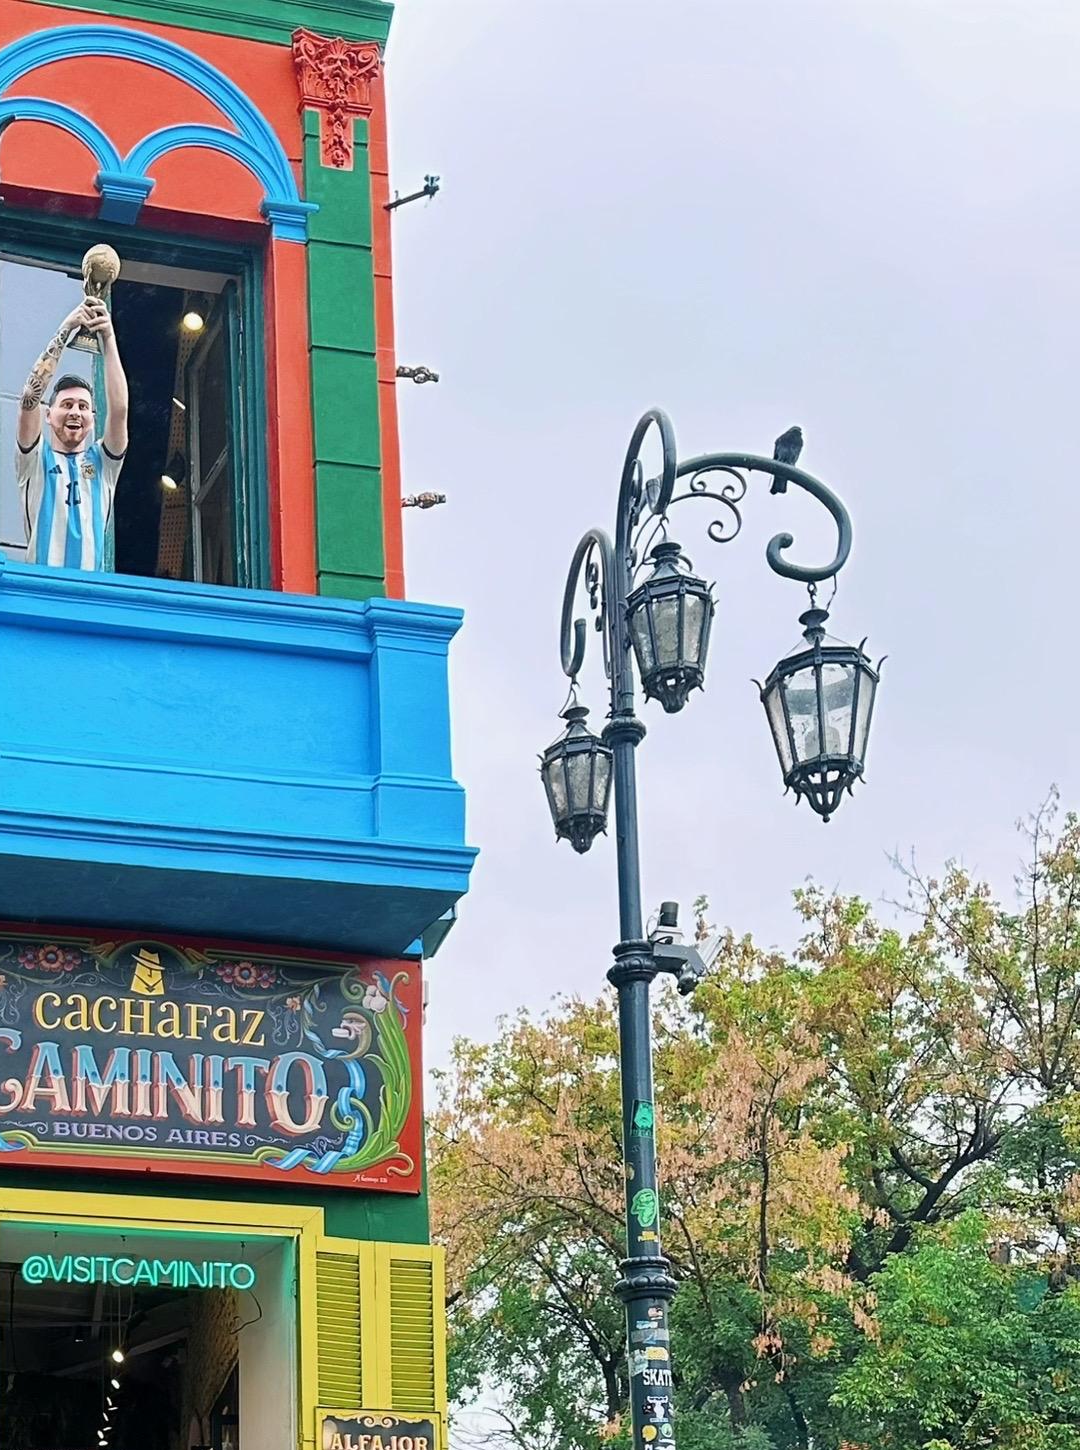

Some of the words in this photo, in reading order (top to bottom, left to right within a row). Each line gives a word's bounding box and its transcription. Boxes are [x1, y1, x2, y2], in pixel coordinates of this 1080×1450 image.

[52, 1120, 160, 1143] BUENOS
[167, 1127, 242, 1149] AIRES
[21, 1253, 257, 1290] @VISITCAMINITO
